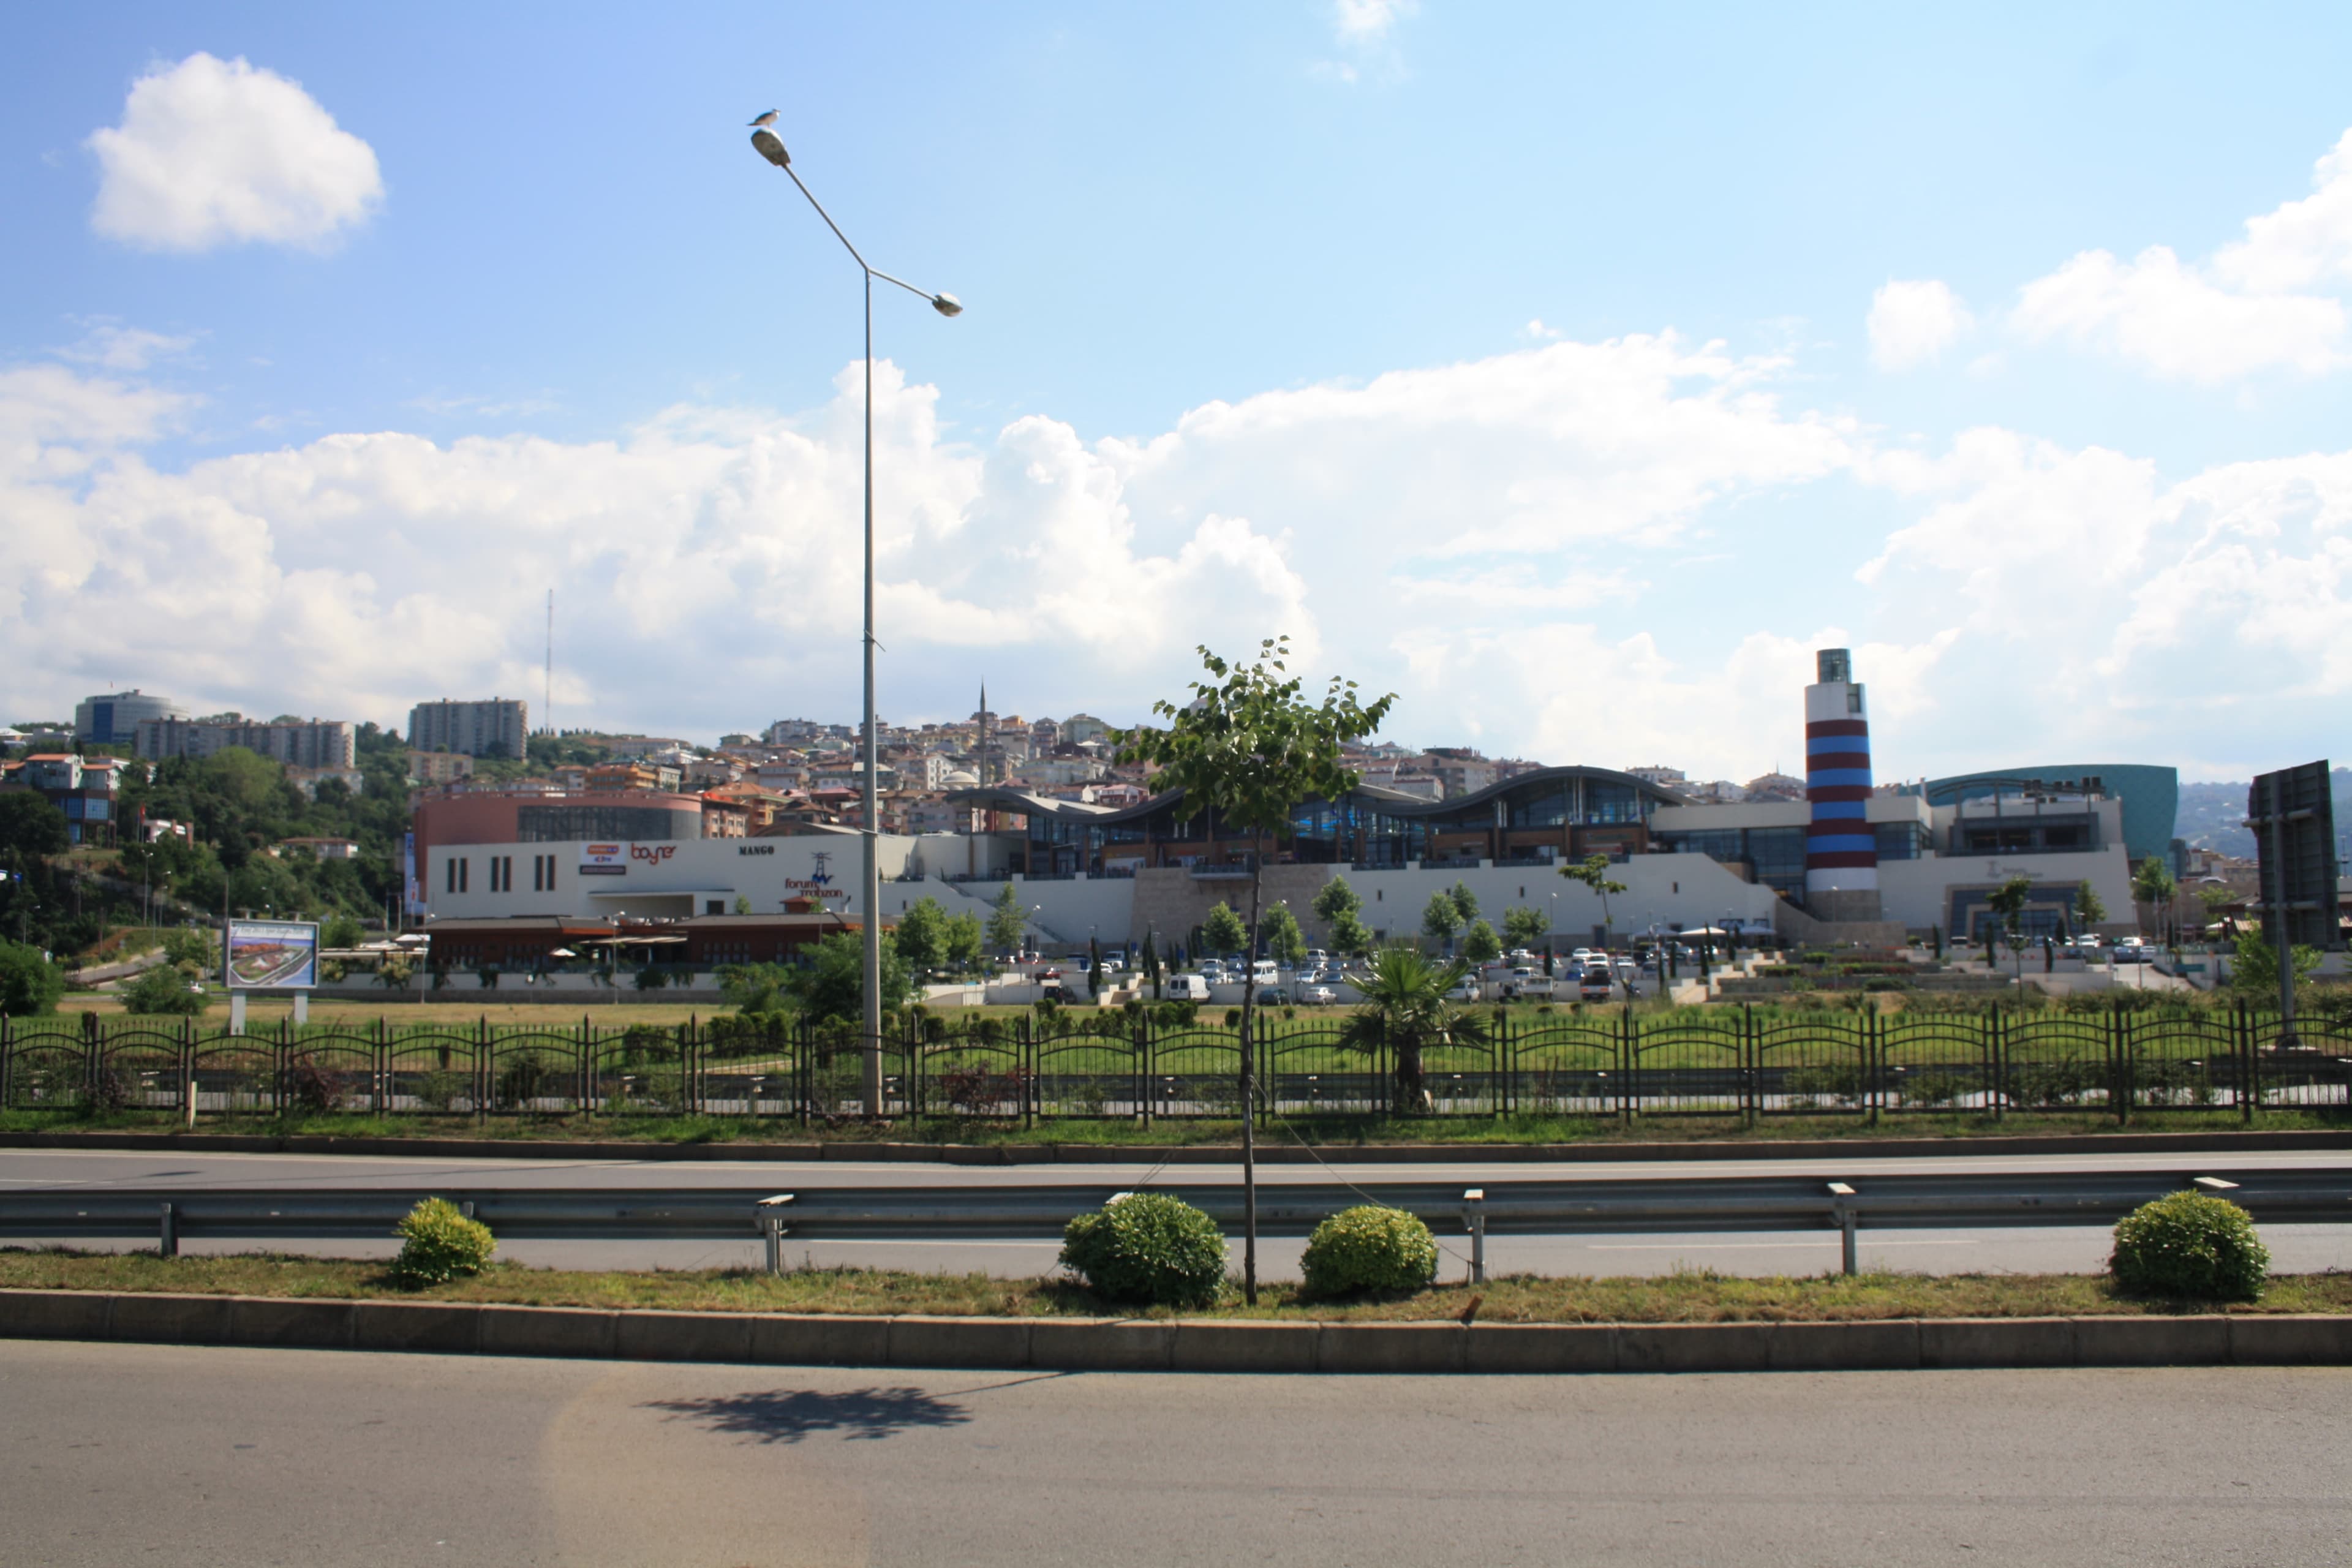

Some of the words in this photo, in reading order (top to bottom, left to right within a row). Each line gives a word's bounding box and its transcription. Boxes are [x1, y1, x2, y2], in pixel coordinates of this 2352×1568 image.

[631, 843, 676, 865] boyner
[739, 846, 774, 855] MANGO
[785, 878, 818, 889] forum
